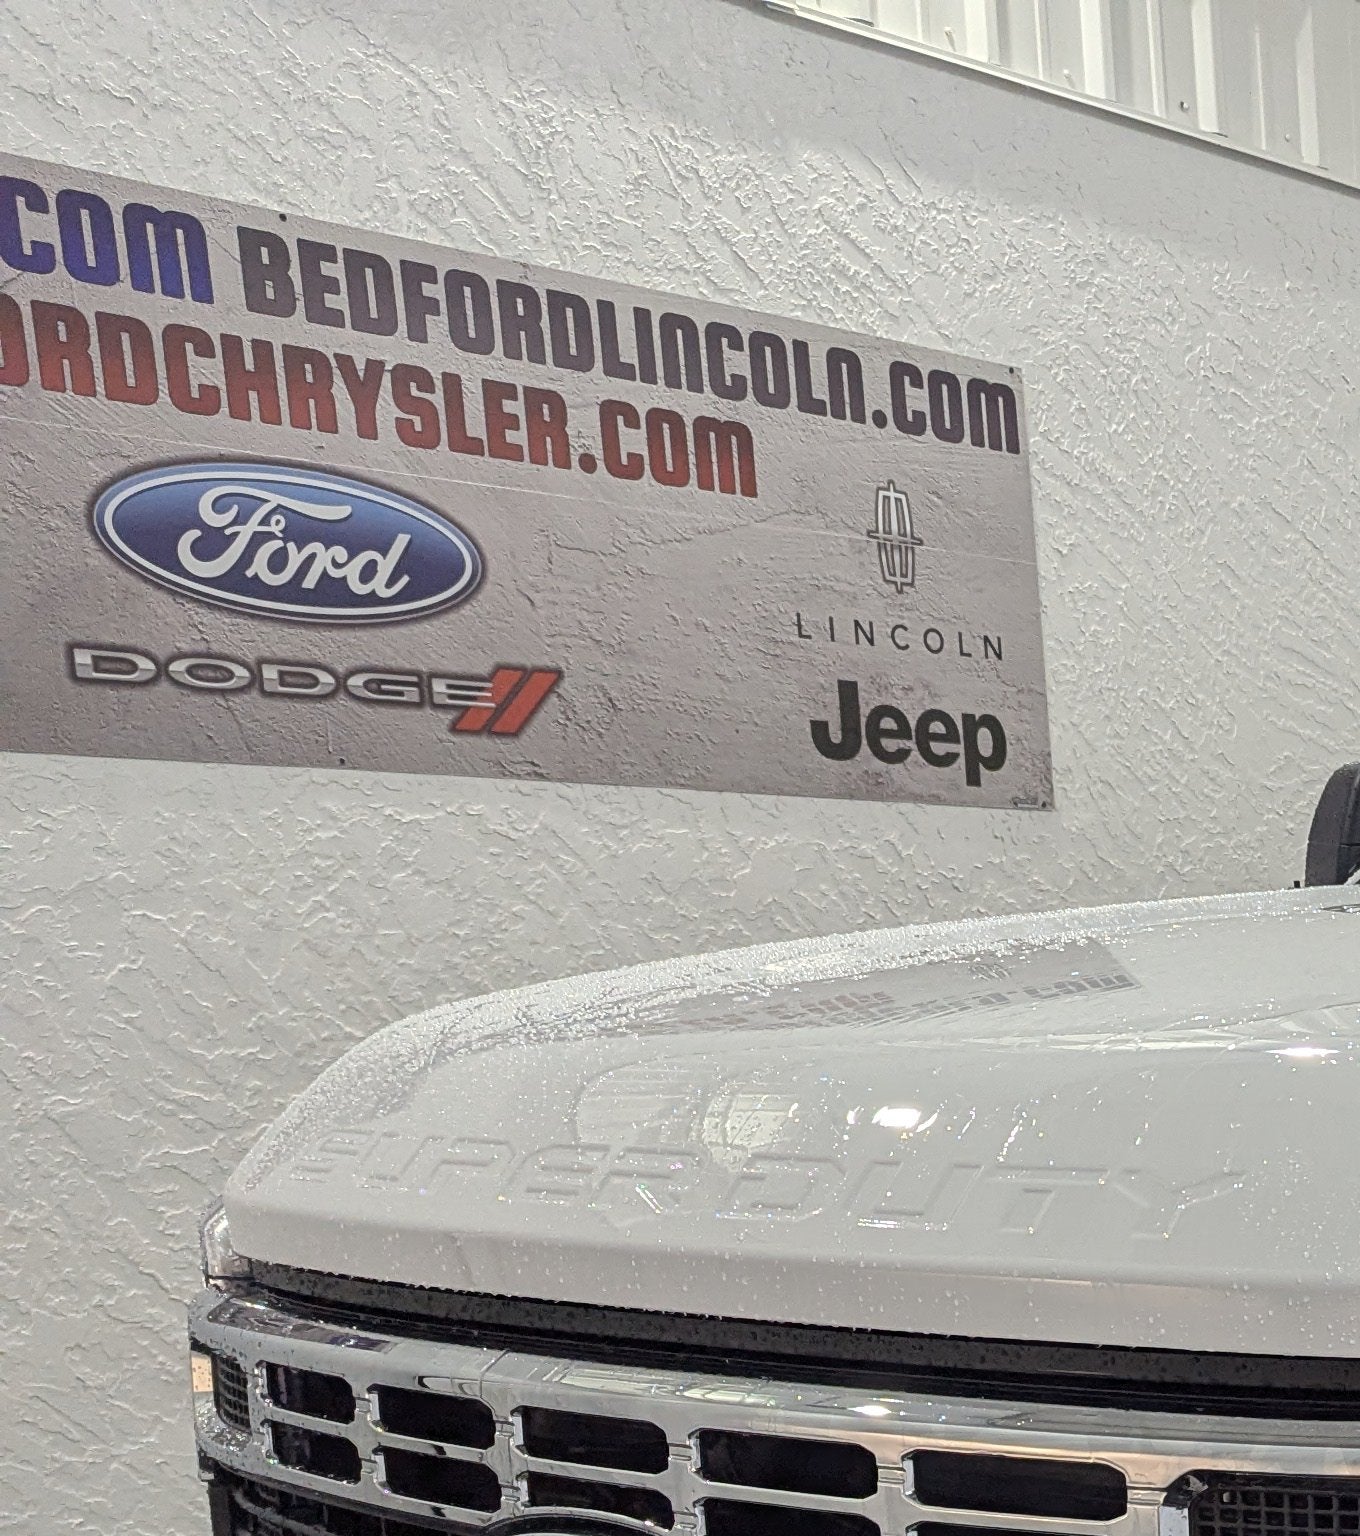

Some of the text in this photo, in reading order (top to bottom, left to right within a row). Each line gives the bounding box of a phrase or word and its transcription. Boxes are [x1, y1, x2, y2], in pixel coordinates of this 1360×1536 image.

[237, 226, 1021, 454] BEDFORDLINCOLN.COM
[177, 485, 411, 599] Ford
[71, 647, 498, 709] DODGE
[796, 612, 1003, 661] LINCOLN
[810, 679, 1007, 788] Jeep
[288, 1128, 1244, 1242] SUPER DUTY
